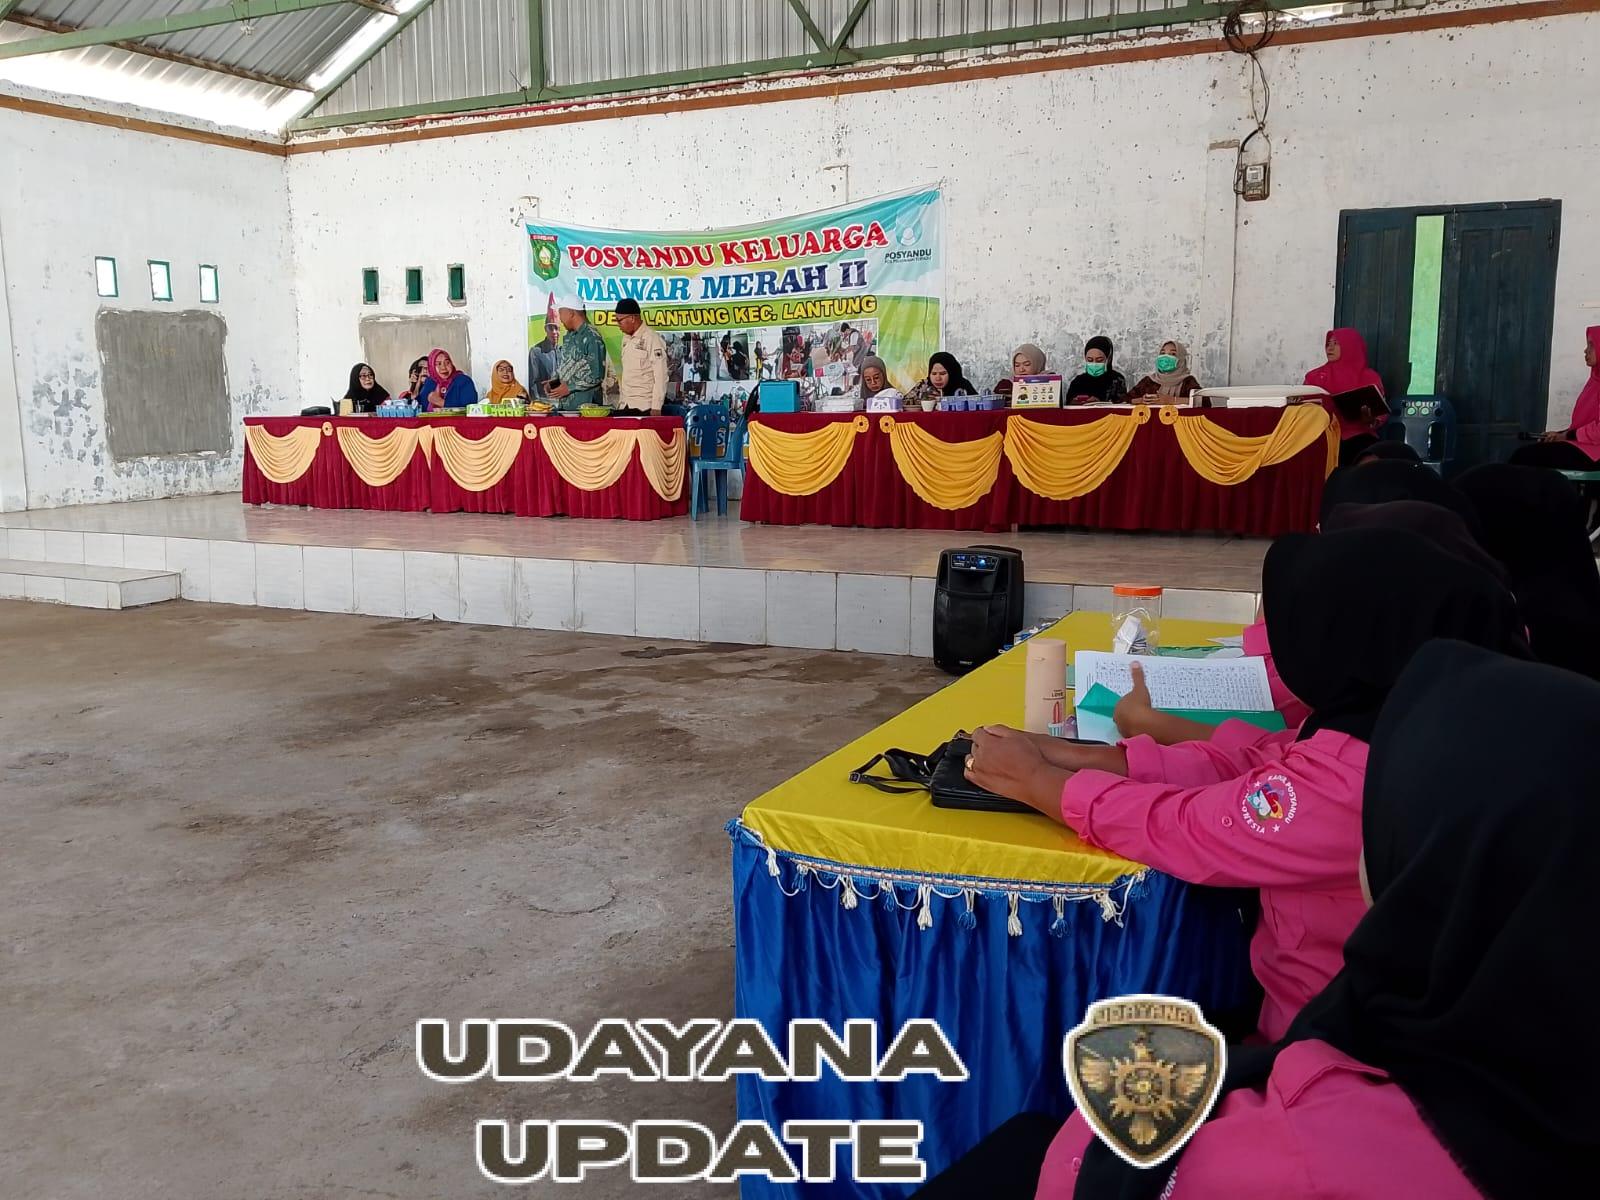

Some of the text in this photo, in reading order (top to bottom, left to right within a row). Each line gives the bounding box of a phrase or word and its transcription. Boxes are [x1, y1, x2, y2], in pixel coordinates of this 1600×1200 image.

[568, 222, 888, 268] POSYANDU KELUARGA
[885, 248, 932, 260] POSYANDU
[577, 260, 868, 302] MAWAR MERAH II
[594, 294, 878, 327] DE LANTUNG KEC. LANTUNG
[1284, 781, 1298, 824] POSYANDU
